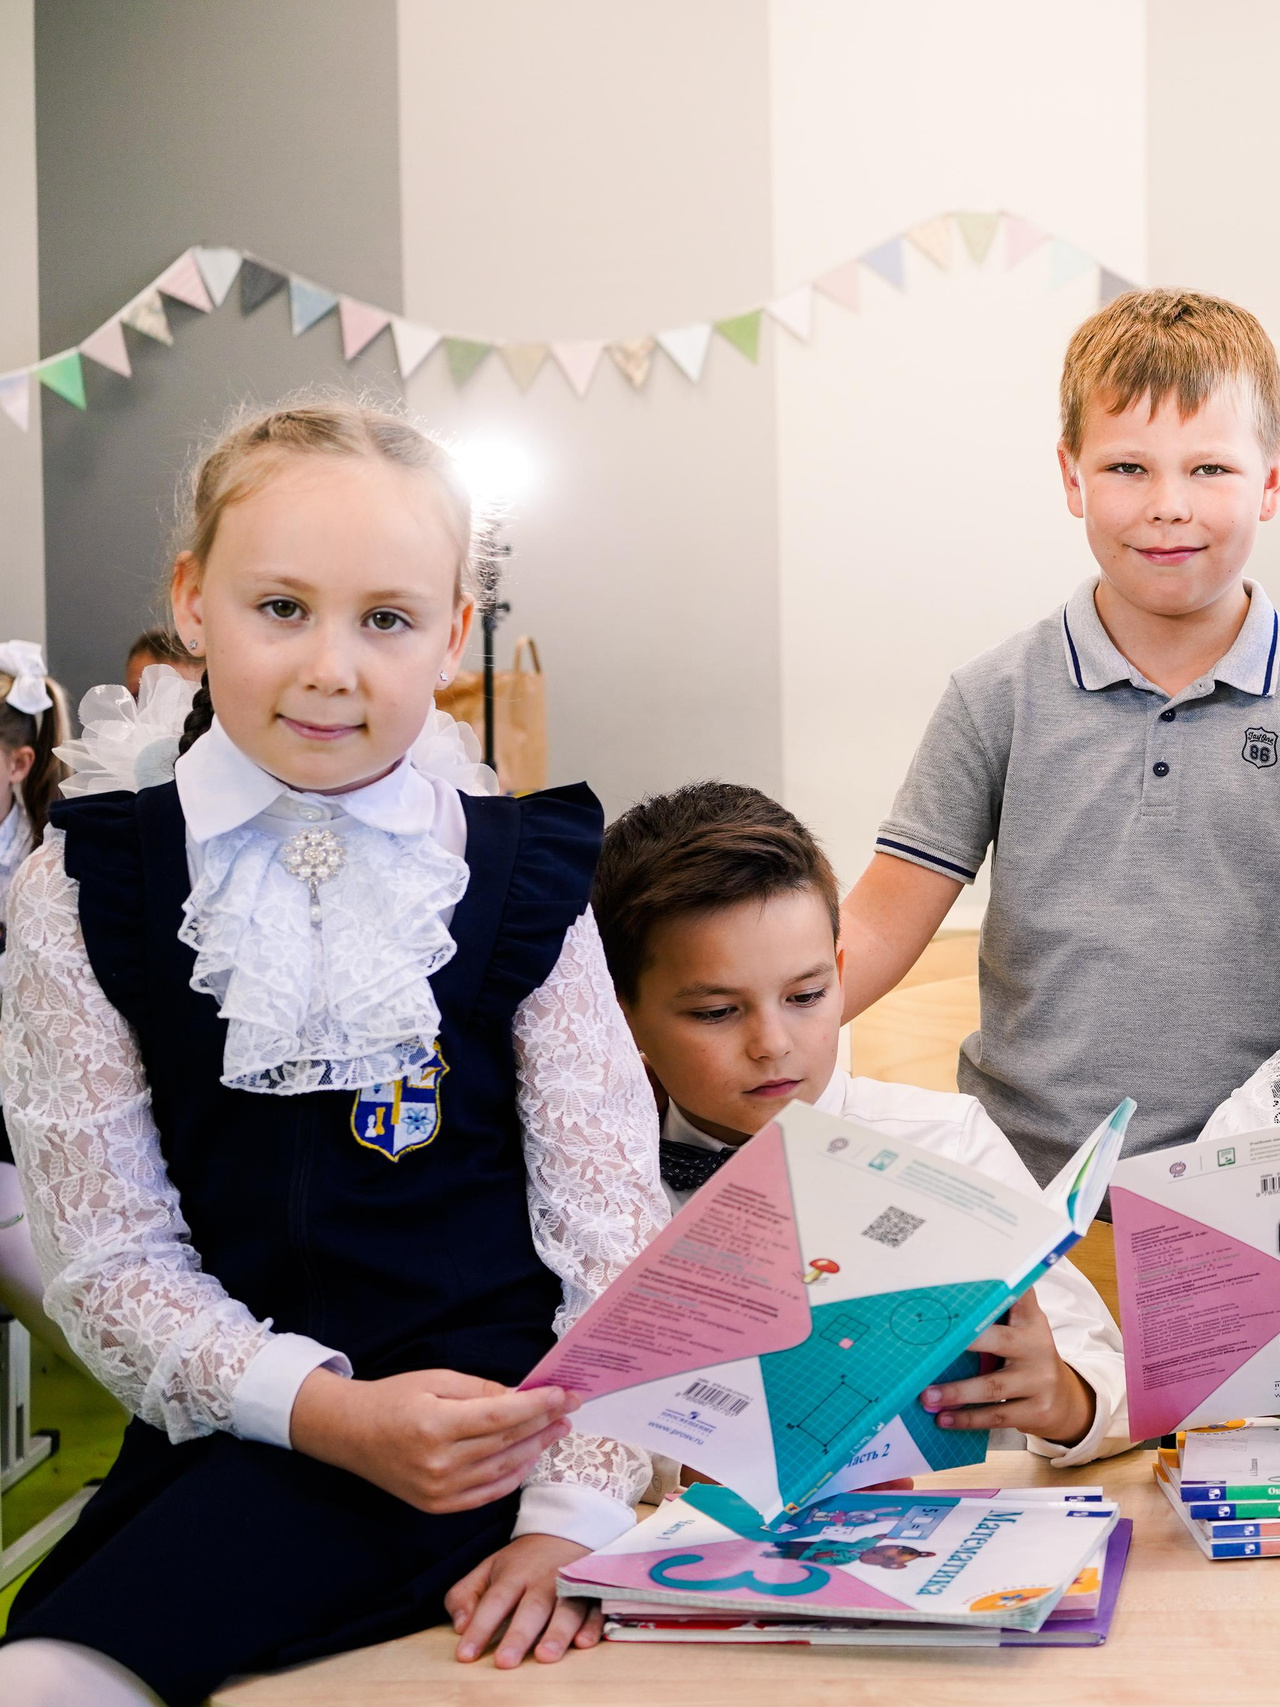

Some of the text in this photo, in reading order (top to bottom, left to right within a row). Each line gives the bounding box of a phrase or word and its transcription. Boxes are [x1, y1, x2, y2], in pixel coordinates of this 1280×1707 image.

[1250, 744, 1271, 763] 86
[648, 1421, 705, 1446] www.prosv.ru
[882, 1443, 891, 1458] 2
[916, 1509, 1025, 1596] Математика
[649, 1554, 830, 1597] 3
